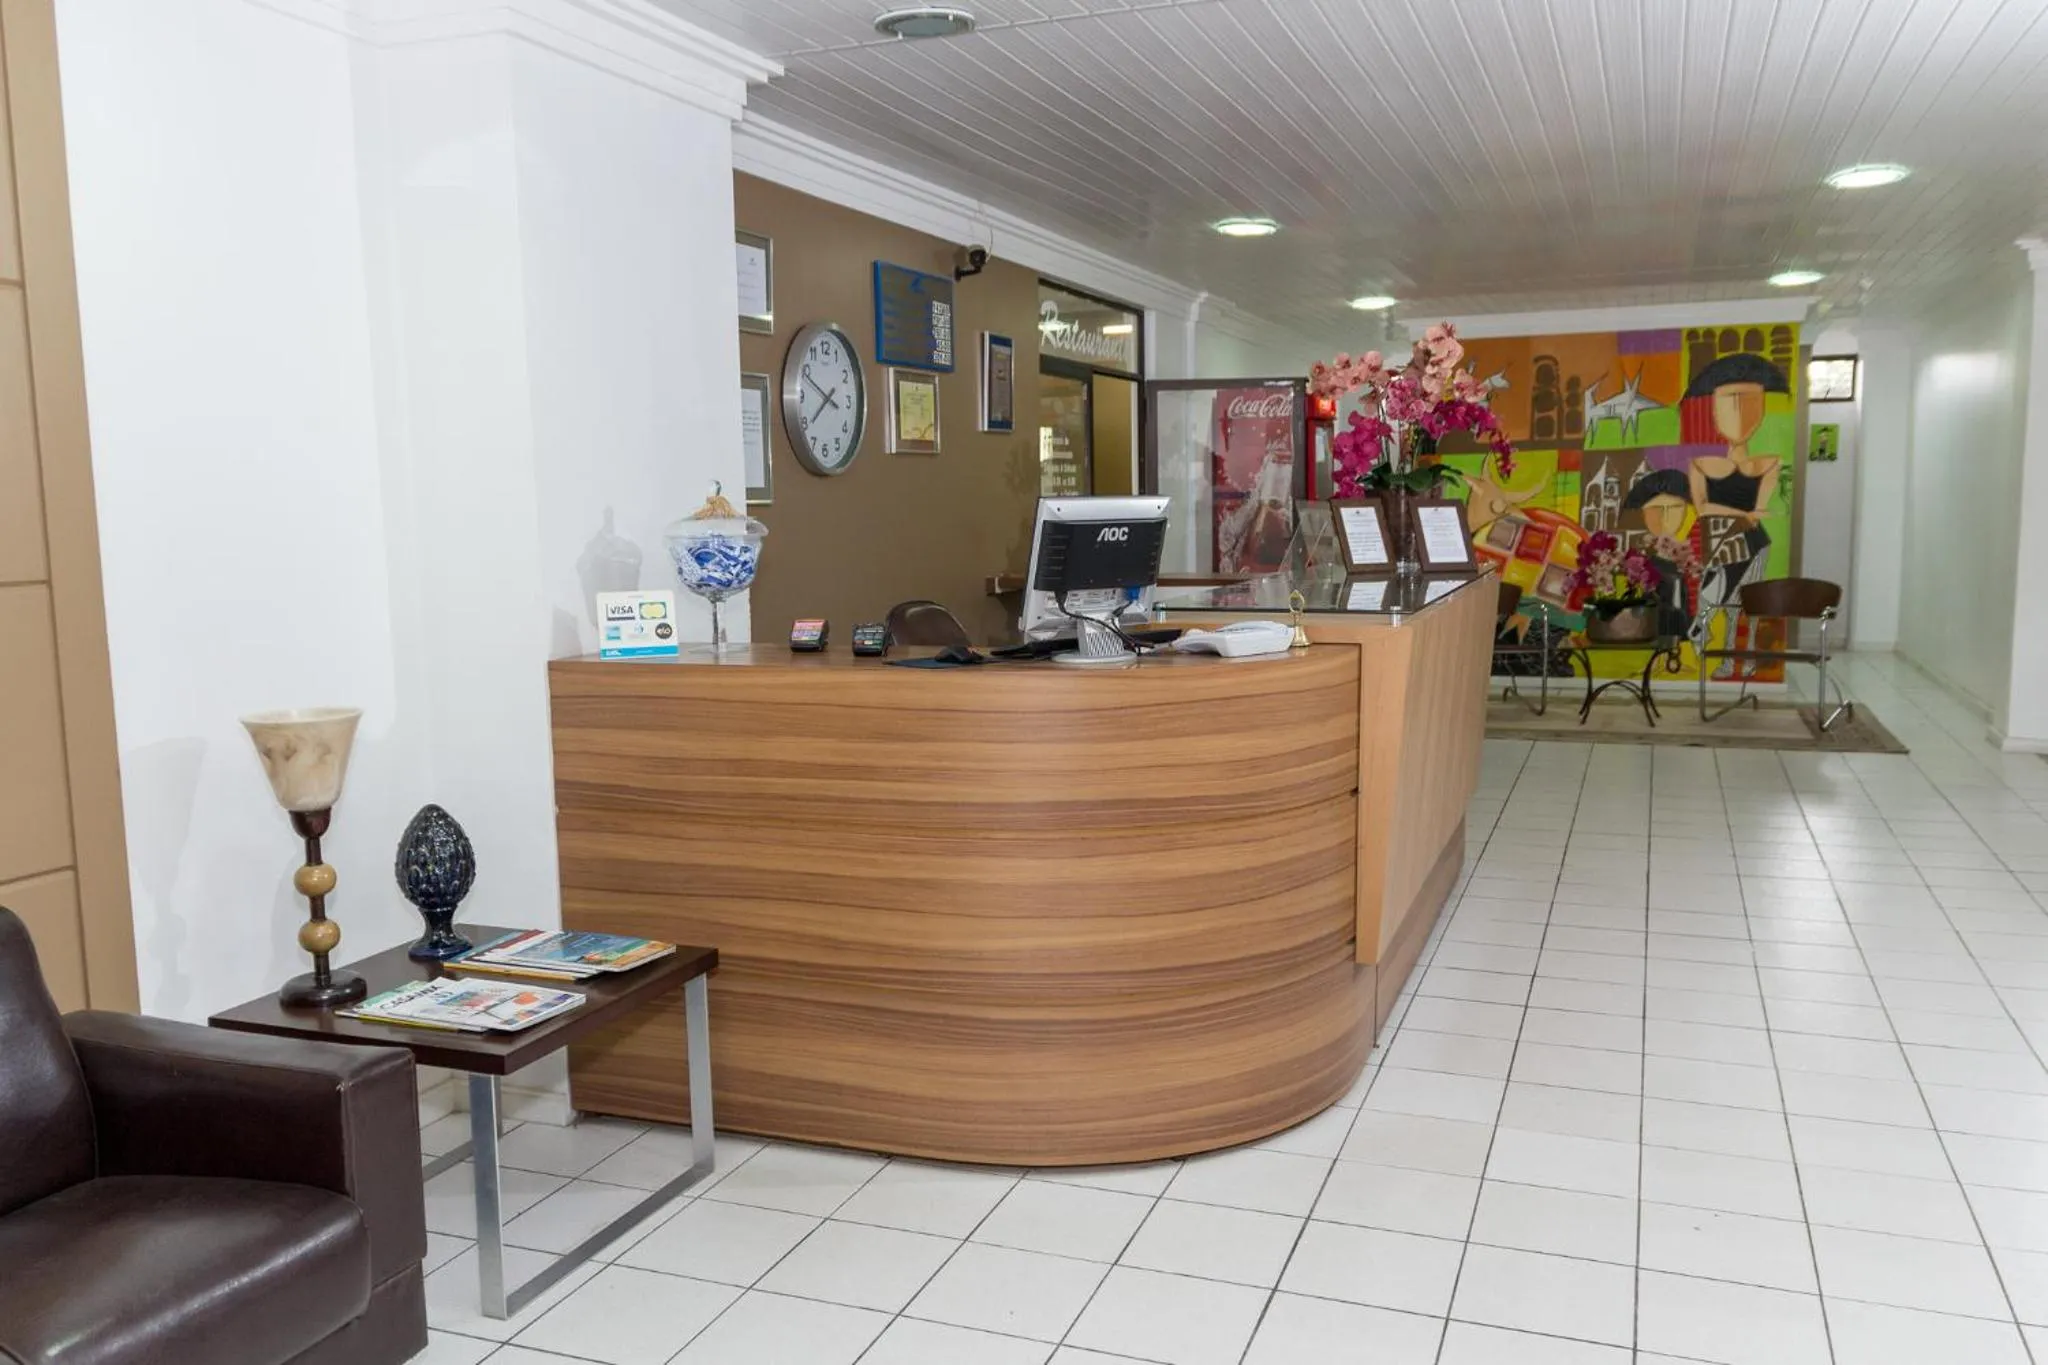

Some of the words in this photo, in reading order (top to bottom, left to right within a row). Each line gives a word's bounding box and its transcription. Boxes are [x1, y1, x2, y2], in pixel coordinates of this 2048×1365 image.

[809, 346, 817, 361] 11
[819, 341, 831, 356] 12
[834, 349, 839, 363] 1
[842, 369, 849, 384] 2
[845, 395, 852, 409] 3
[801, 416, 808, 431] 8
[841, 420, 848, 434] 4
[810, 436, 817, 453] 7
[821, 443, 829, 458] 6
[834, 437, 841, 452] 5
[1097, 526, 1129, 542] AOC
[609, 604, 634, 615] VISA
